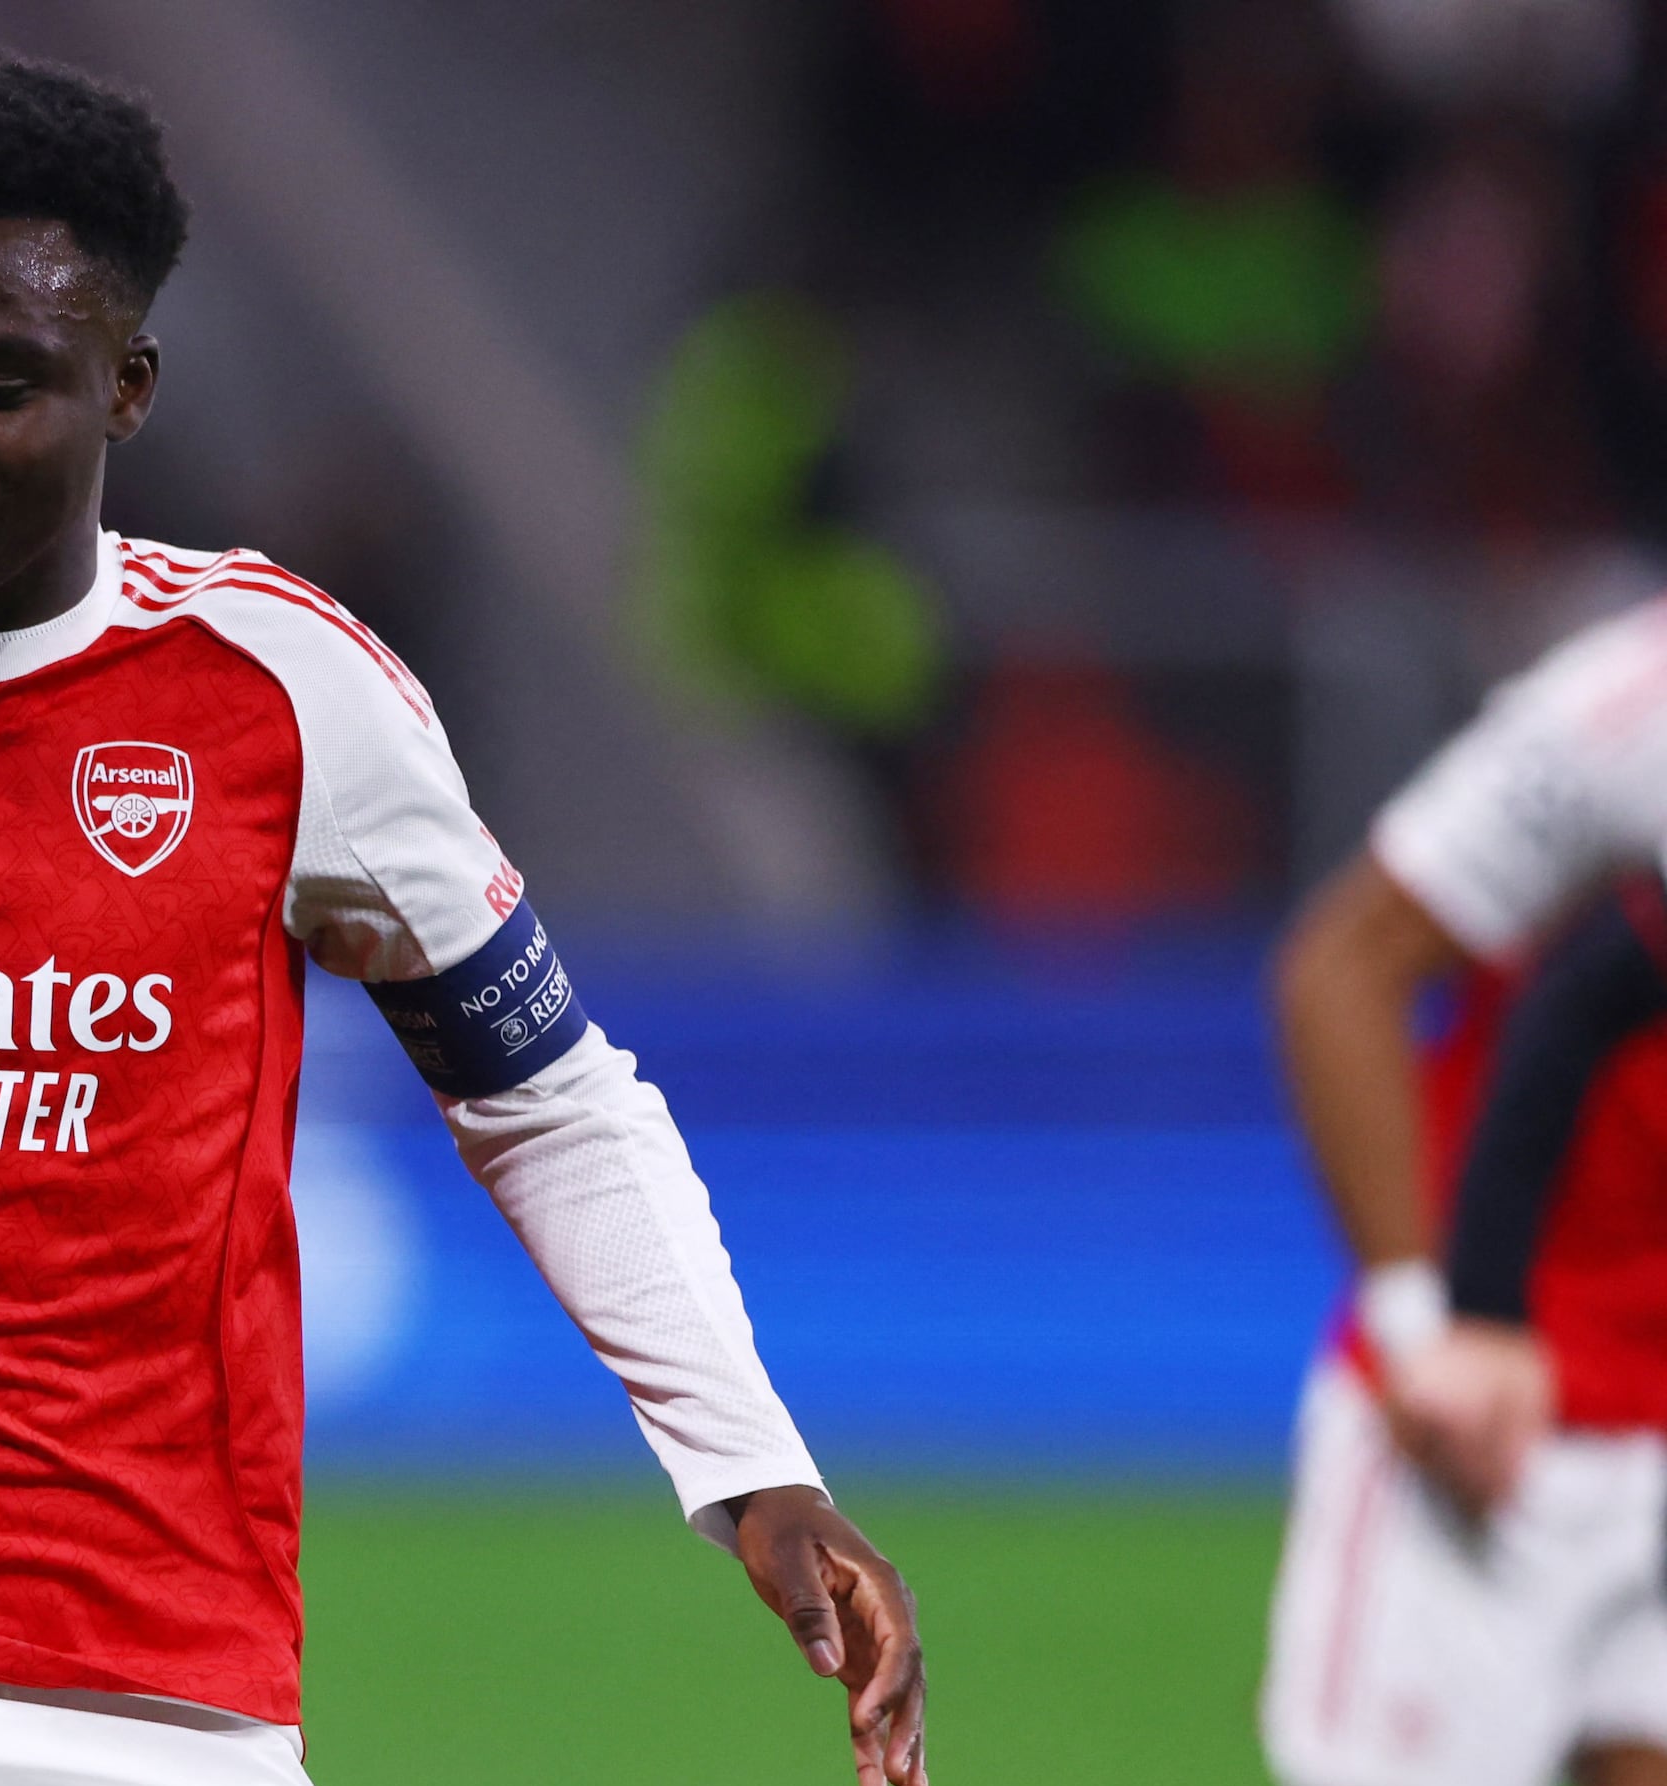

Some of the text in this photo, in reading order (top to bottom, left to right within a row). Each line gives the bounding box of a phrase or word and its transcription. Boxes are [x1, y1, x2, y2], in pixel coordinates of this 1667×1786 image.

[90, 762, 178, 786] Arsenal
[460, 985, 502, 1019] NO
[500, 959, 529, 991] TO
[525, 918, 548, 967] RAC
[530, 959, 569, 1026] RESPE
